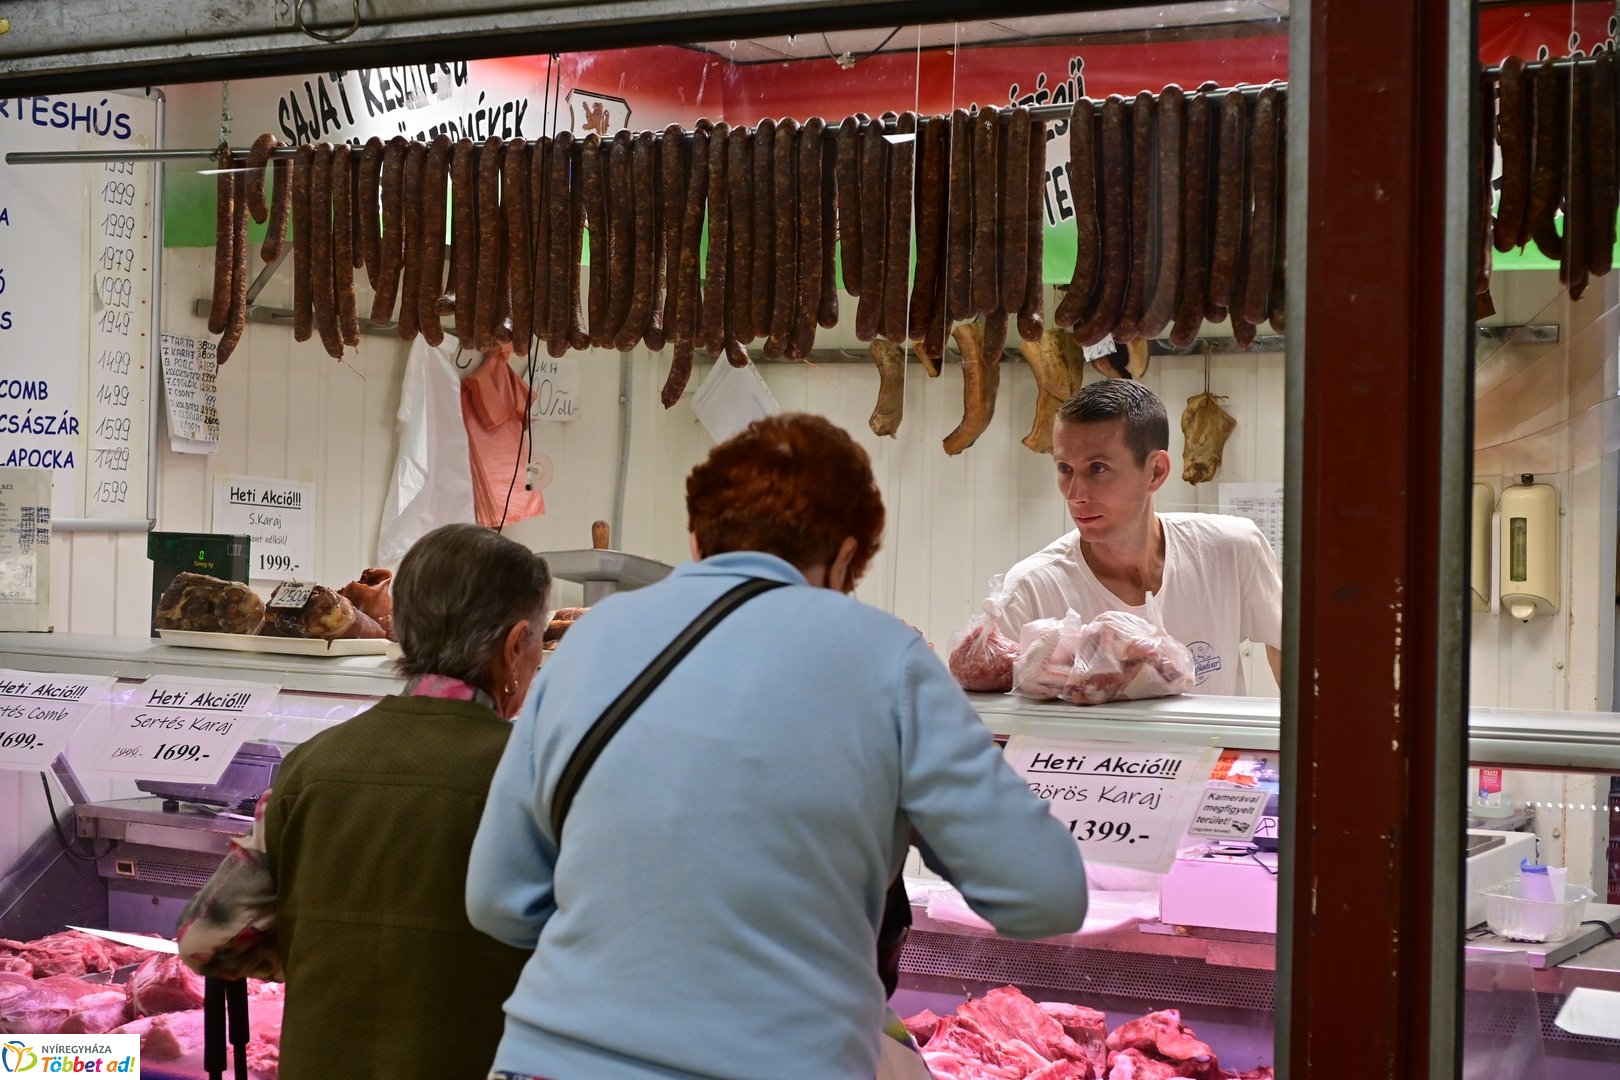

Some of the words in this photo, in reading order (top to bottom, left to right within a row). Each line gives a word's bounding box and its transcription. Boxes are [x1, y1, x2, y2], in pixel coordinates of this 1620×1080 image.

[101, 180, 135, 206] 1999
[101, 213, 135, 239] 1999
[99, 246, 134, 273] 1979
[100, 276, 131, 308] 1999
[98, 310, 130, 336] 1949
[98, 349, 131, 375] 1499
[0, 379, 48, 401] COMB
[96, 384, 130, 407] 1499
[0, 408, 79, 435] CSÁSZÁR
[95, 417, 131, 441] 1599
[95, 447, 130, 471] 1499
[94, 480, 128, 503] 1599
[230, 487, 256, 502] Heti
[261, 490, 301, 506] Akció!!!
[260, 554, 299, 572] 1999.-
[0, 680, 31, 694] Heti
[31, 683, 88, 699] Akció!!!
[149, 689, 188, 706] Heti
[190, 692, 251, 710] Akció!!!
[28, 707, 69, 721] Comb
[131, 713, 184, 731] Sertés
[189, 717, 236, 736] Karaj
[152, 743, 210, 762] 1699.-
[1030, 753, 1086, 771] Heti
[1094, 757, 1182, 777] Akció!!!
[1098, 786, 1164, 810] Karaj
[1208, 792, 1260, 804] Kamerával
[1203, 805, 1255, 816] megfigyelt
